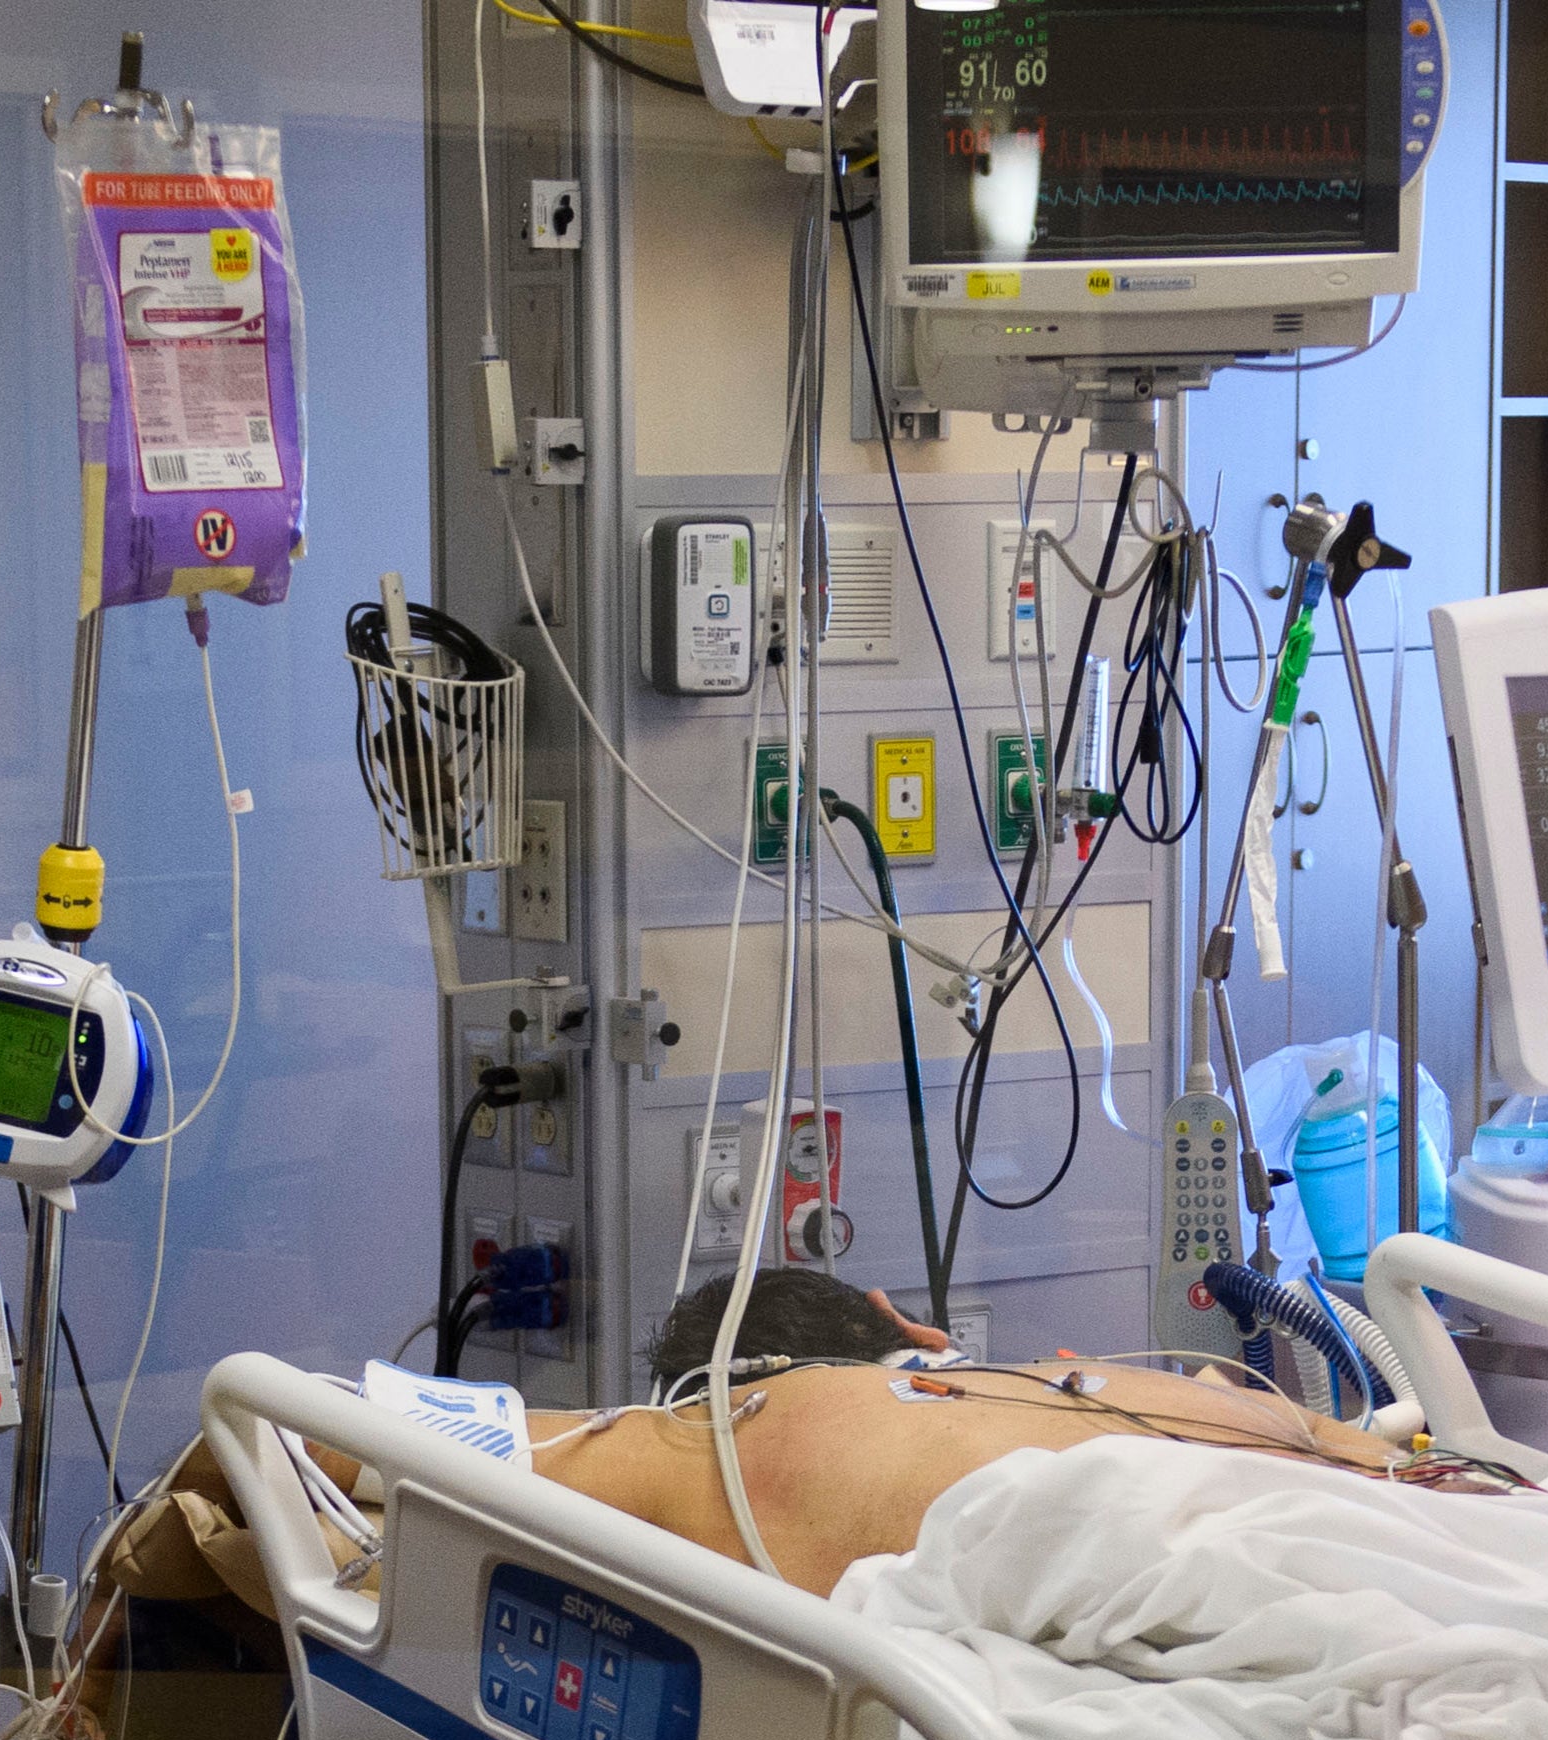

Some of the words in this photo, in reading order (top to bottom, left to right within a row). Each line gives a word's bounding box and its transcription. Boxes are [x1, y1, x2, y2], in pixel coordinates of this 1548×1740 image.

[1015, 59, 1047, 87] 60
[95, 181, 125, 199] FOR
[131, 182, 162, 200] TUBE
[164, 183, 226, 203] FEEDING
[230, 185, 264, 202] ONLY
[216, 250, 232, 259] YOU
[233, 249, 248, 259] ARE
[982, 282, 1007, 296] JUL
[1088, 277, 1111, 290] AEM
[201, 518, 230, 551] IV
[884, 747, 912, 756] MEDICAL
[914, 747, 926, 755] AIR
[561, 1592, 634, 1639] stryker
